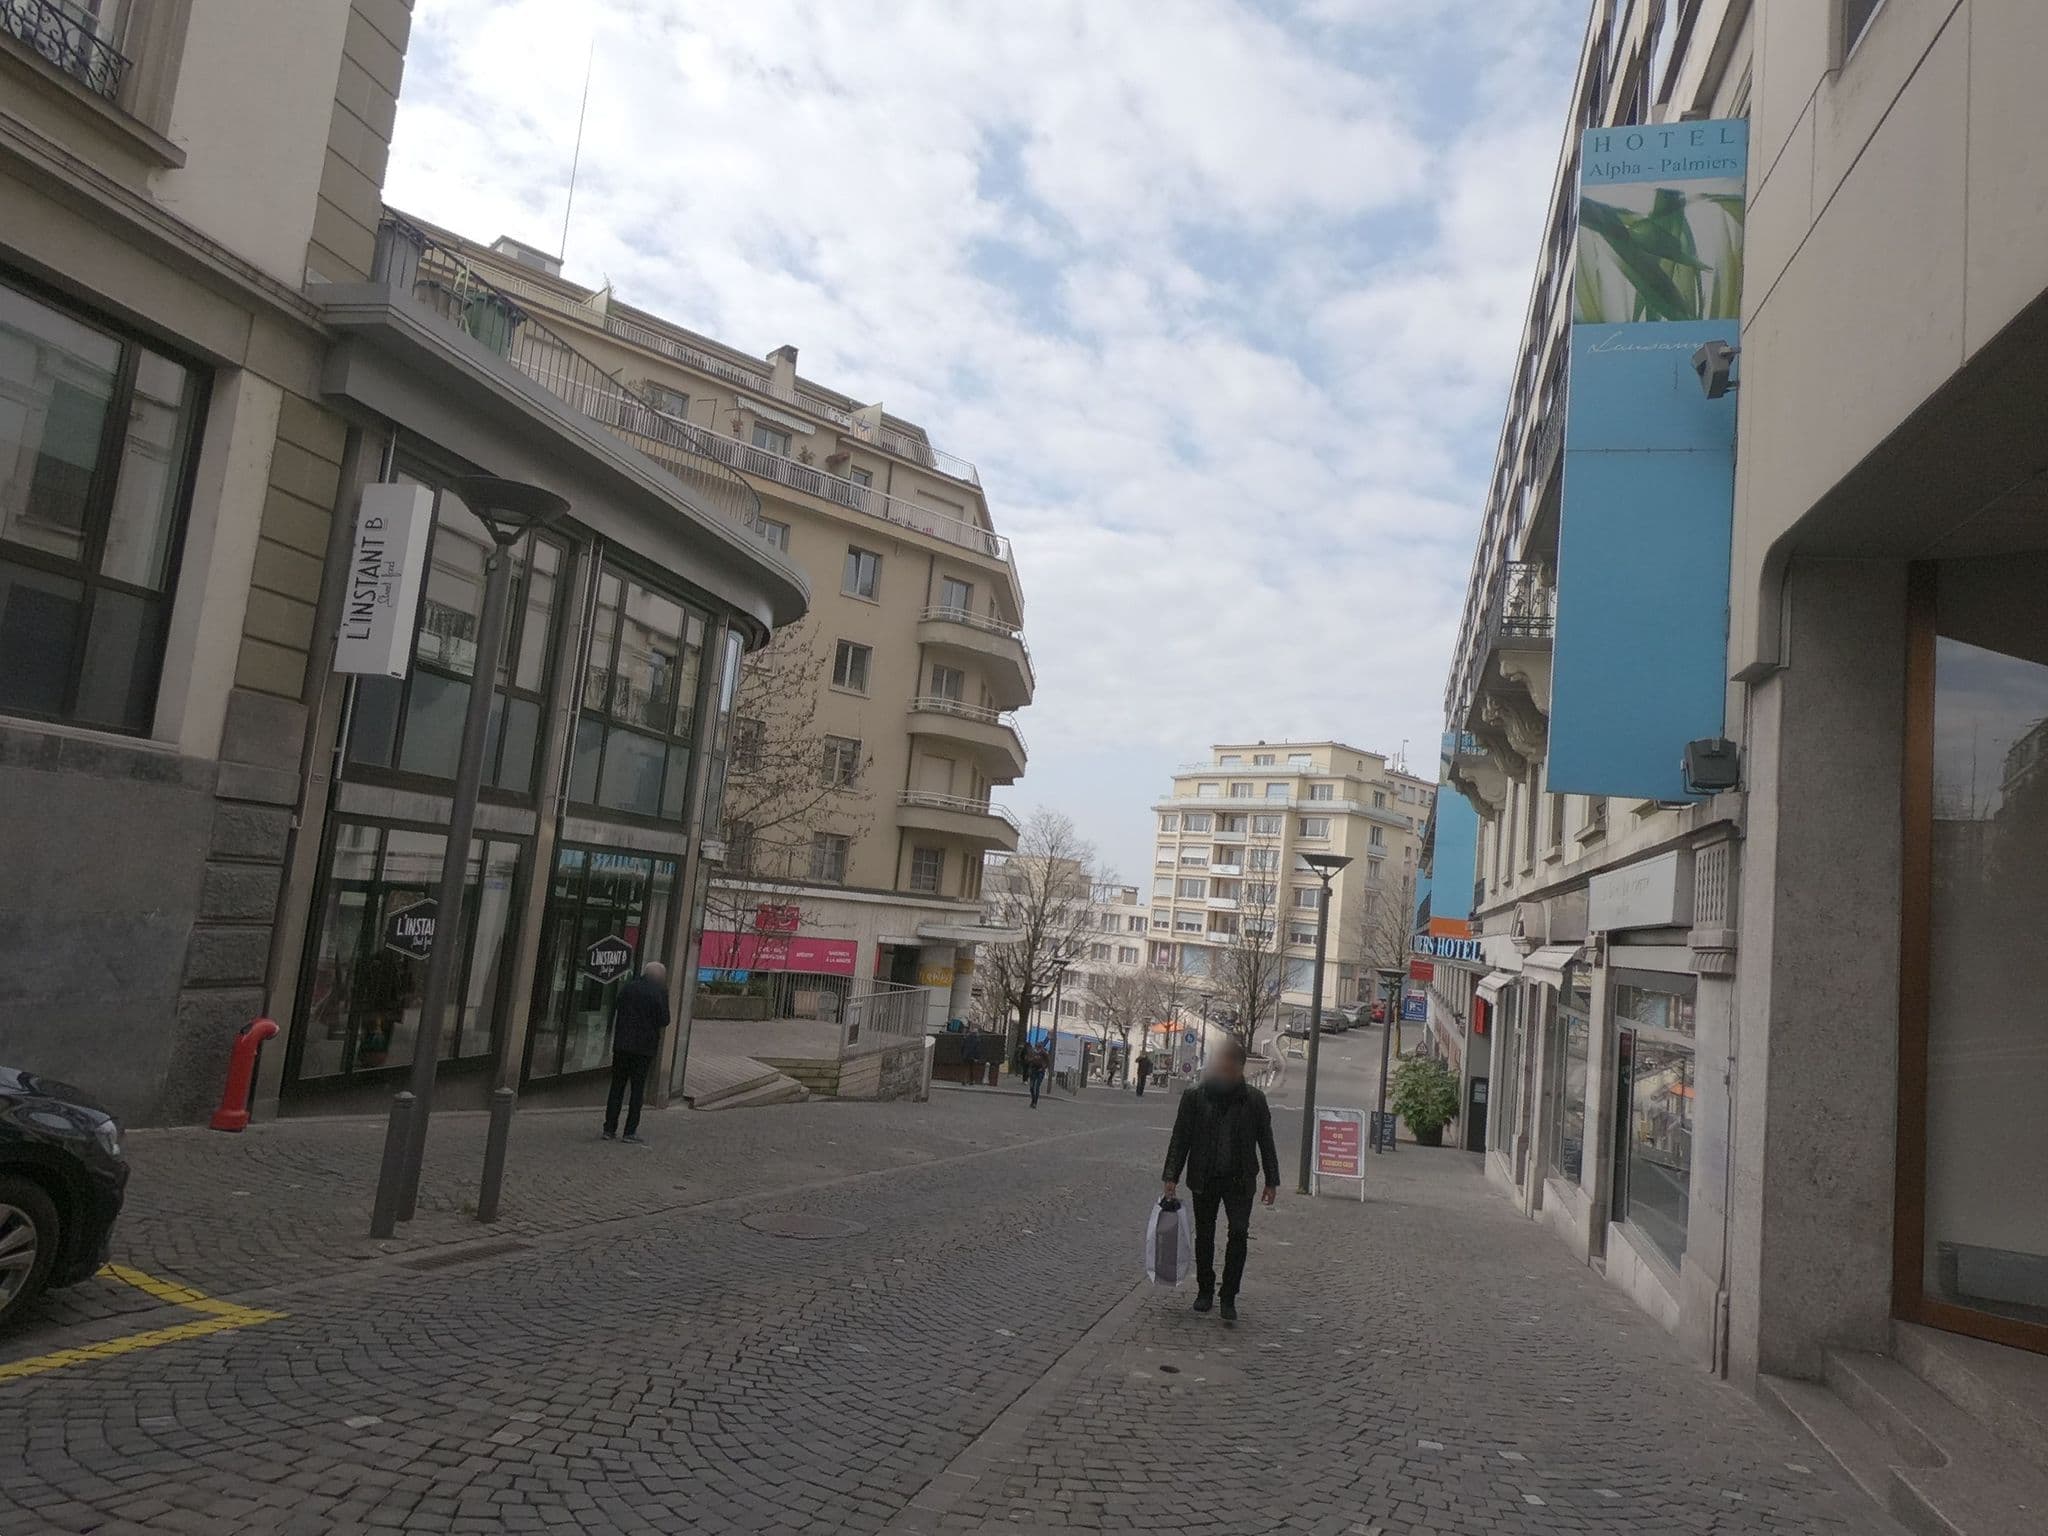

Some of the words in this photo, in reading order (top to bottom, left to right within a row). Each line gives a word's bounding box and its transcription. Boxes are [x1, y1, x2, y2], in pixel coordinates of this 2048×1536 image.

[1594, 127, 1736, 153] HOTEL
[1589, 160, 1641, 179] Alpha
[1661, 156, 1738, 173] Palmiers
[343, 536, 385, 640] L'INSTANT
[365, 517, 388, 530] B
[1436, 937, 1482, 961] HOTEL
